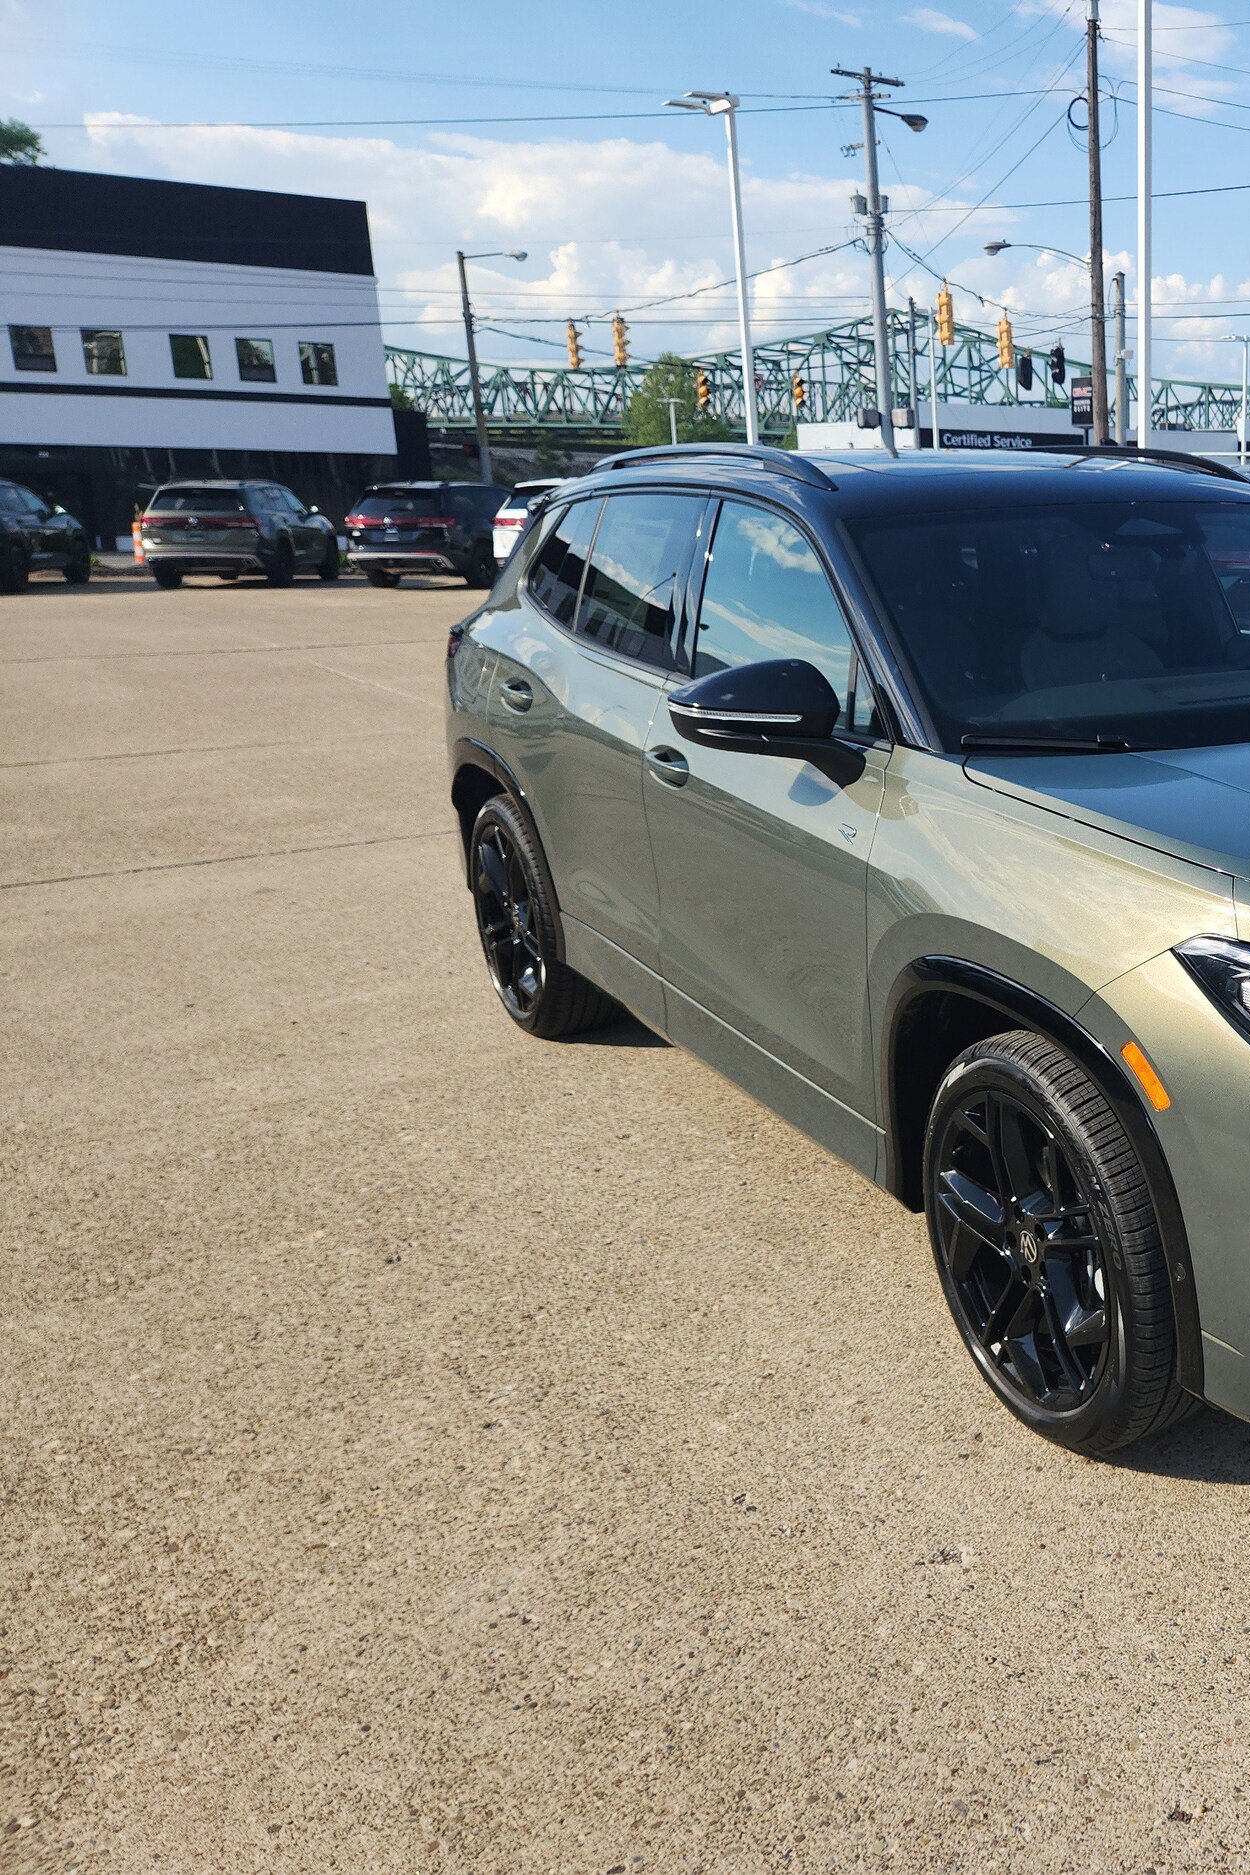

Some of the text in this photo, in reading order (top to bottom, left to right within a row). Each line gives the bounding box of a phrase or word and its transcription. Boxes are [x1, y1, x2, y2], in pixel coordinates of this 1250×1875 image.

[943, 433, 1033, 449] Certified Service
[1096, 1199, 1123, 1271] ZERO
